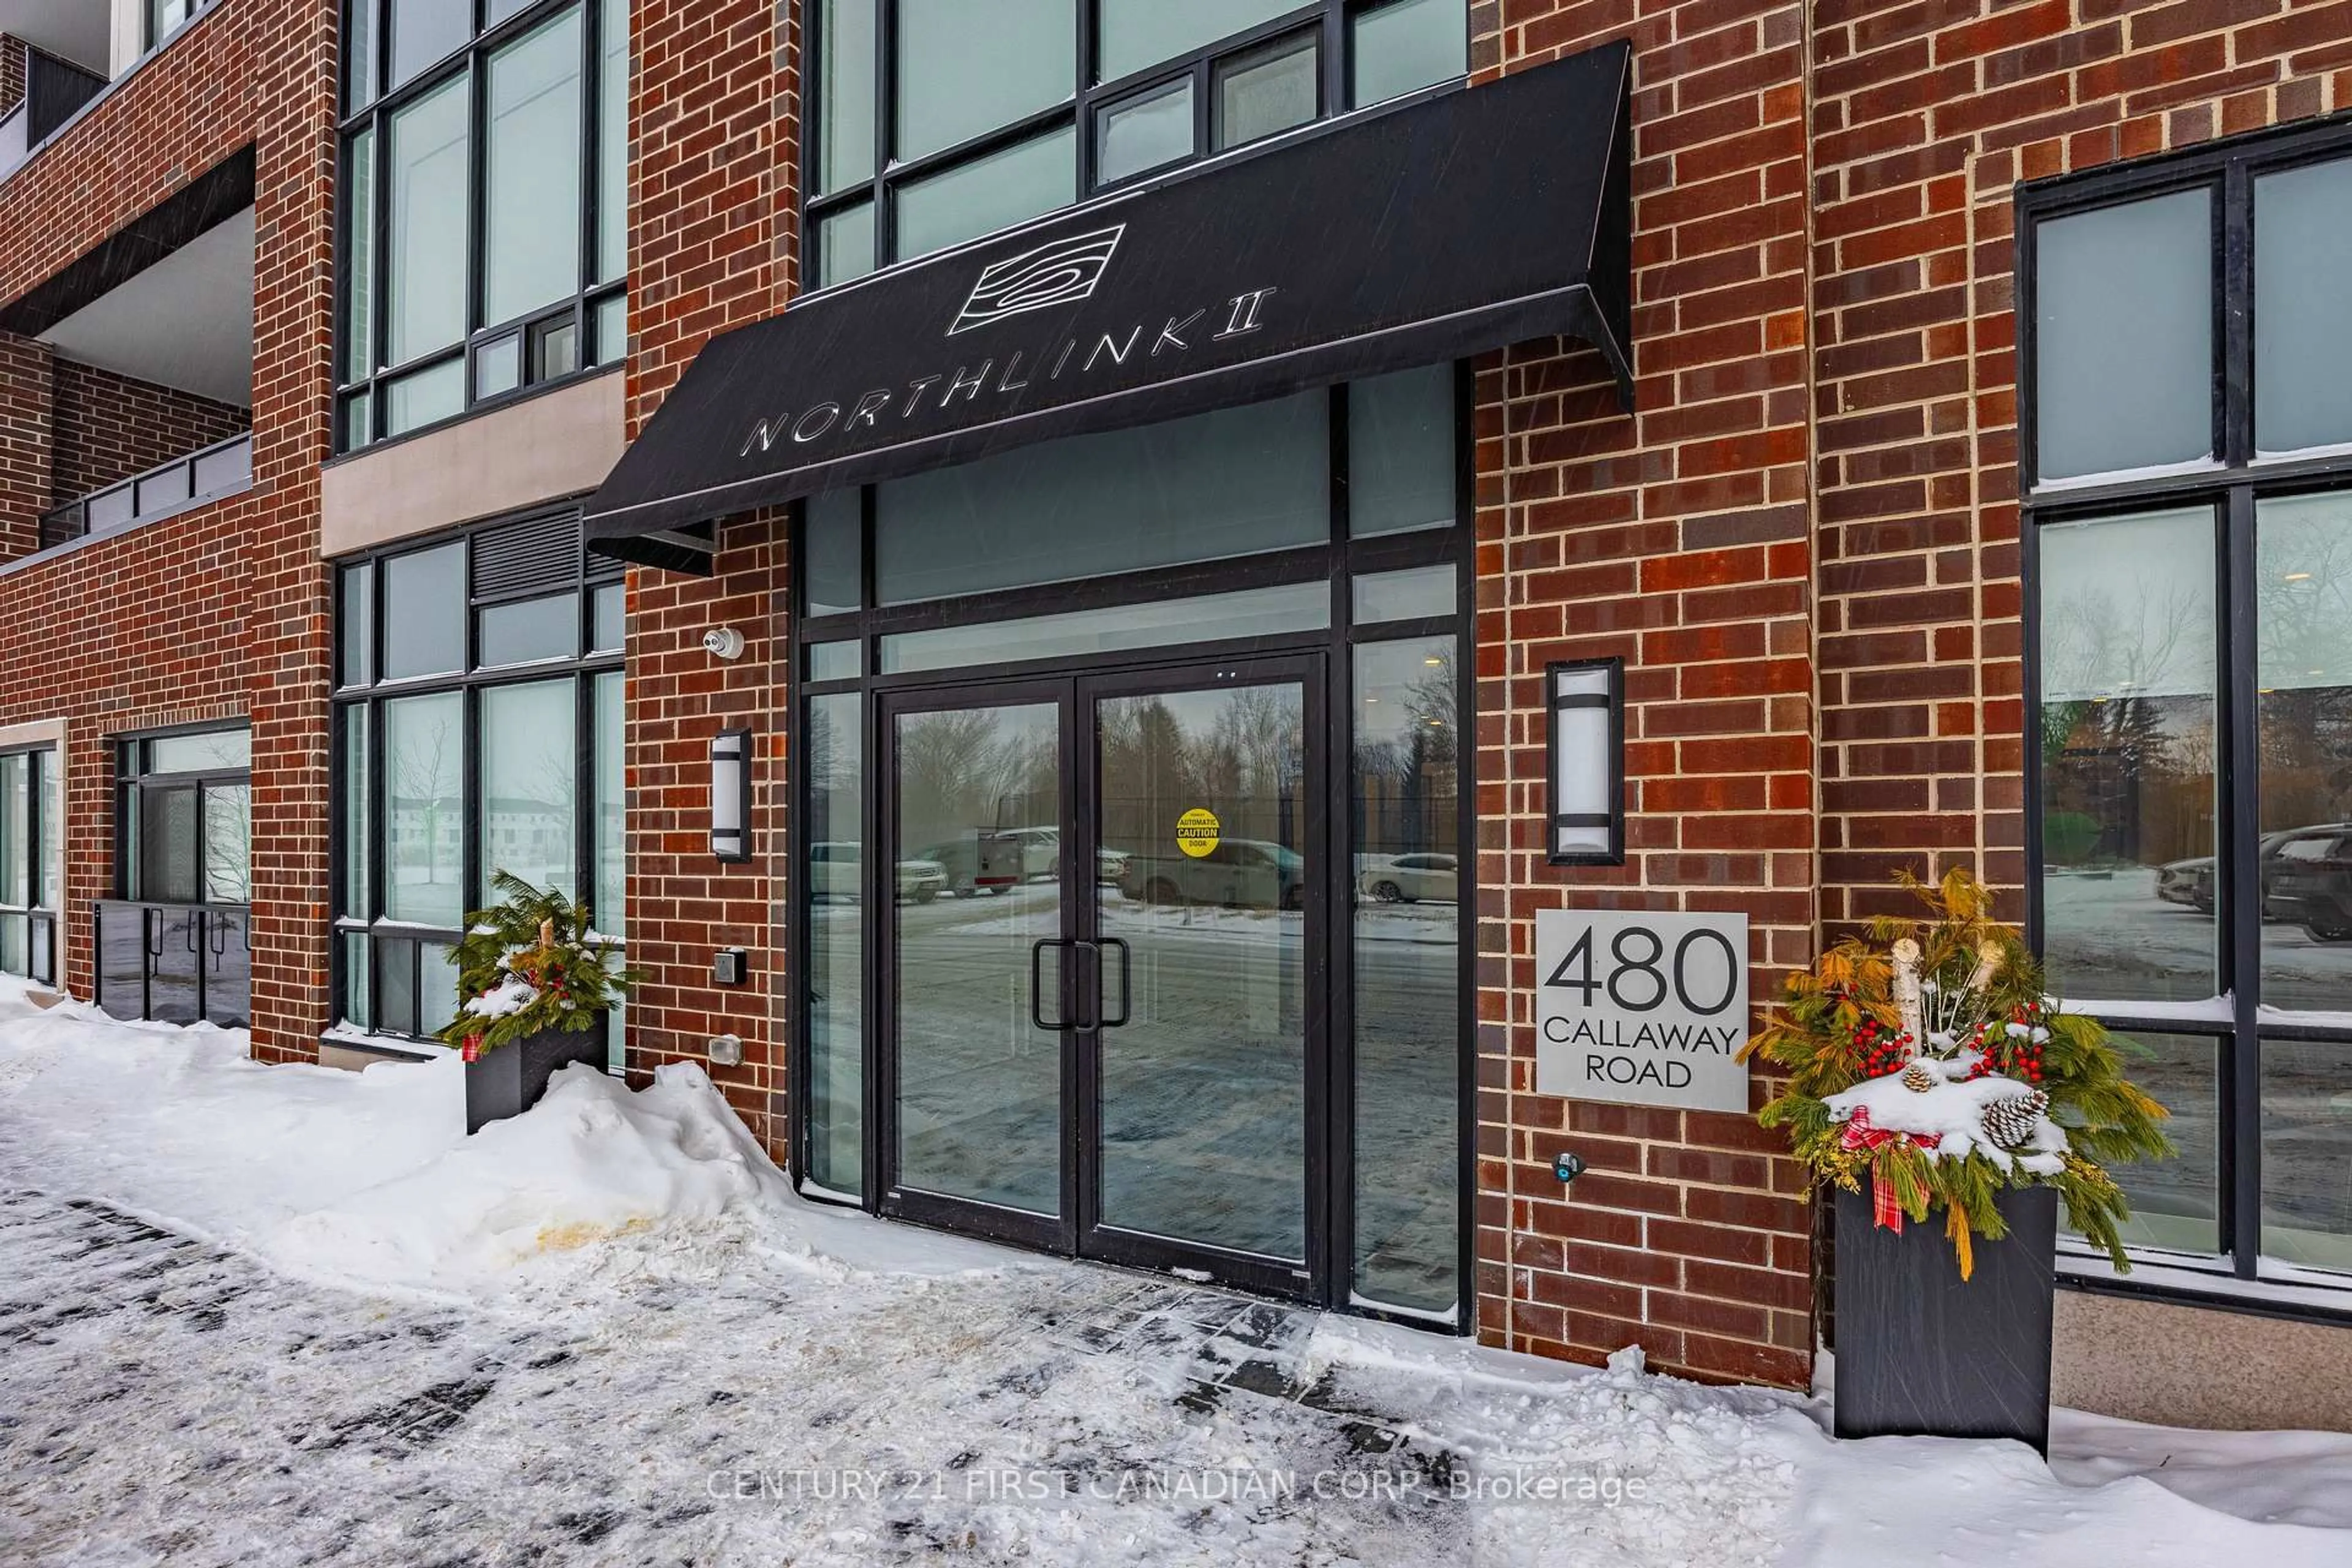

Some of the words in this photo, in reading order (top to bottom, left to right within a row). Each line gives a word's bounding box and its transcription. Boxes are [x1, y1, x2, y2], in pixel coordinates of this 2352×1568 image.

[739, 309, 1206, 458] NORTHLINK
[1213, 287, 1277, 341] II
[1178, 828, 1217, 837] CAUTION
[1544, 925, 1738, 1016] 480
[1544, 1016, 1739, 1055] CALLAWAY
[1587, 1054, 1691, 1088] ROAD
